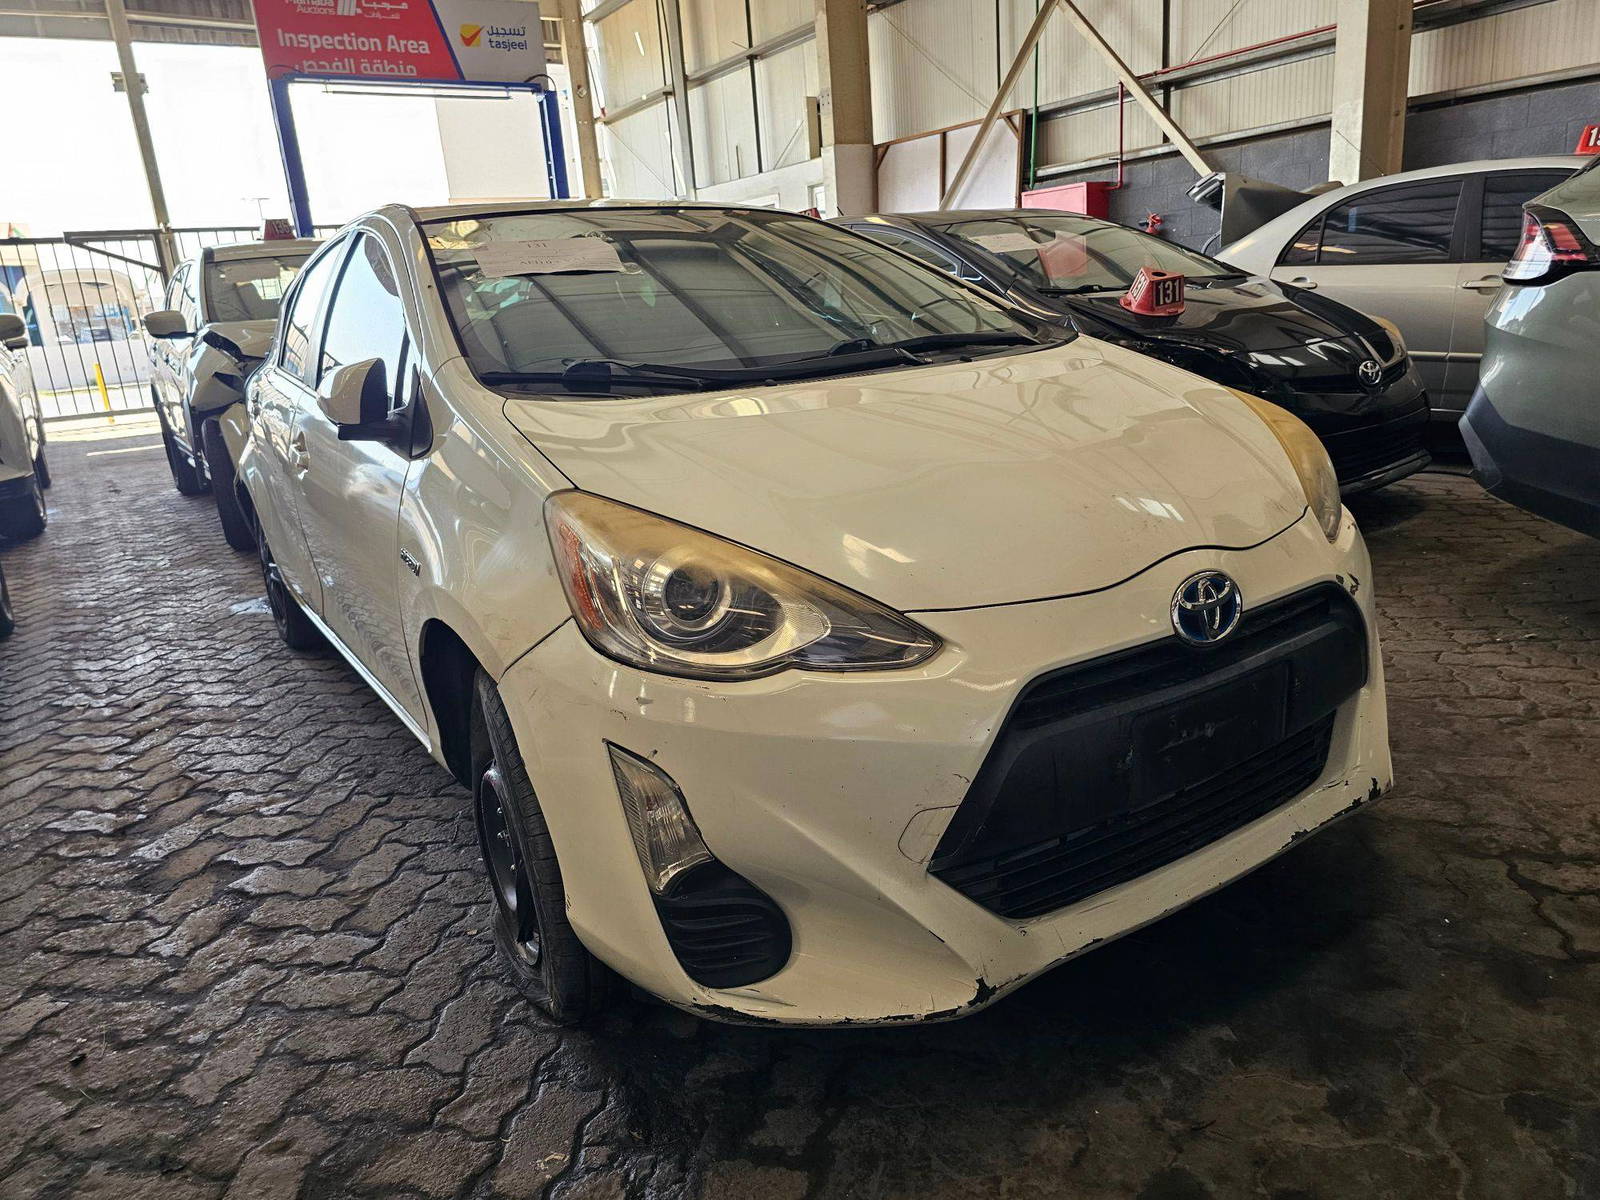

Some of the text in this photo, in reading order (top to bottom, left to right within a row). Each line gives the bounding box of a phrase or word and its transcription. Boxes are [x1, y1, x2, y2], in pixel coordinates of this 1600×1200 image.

[277, 28, 430, 54] Inspection Area
[486, 25, 526, 38] تسجيل
[488, 39, 528, 50] tasjeel
[361, 58, 417, 76] منطقة
[1589, 127, 1600, 147] 1
[1131, 271, 1147, 301] 131
[1158, 279, 1180, 305] 131
